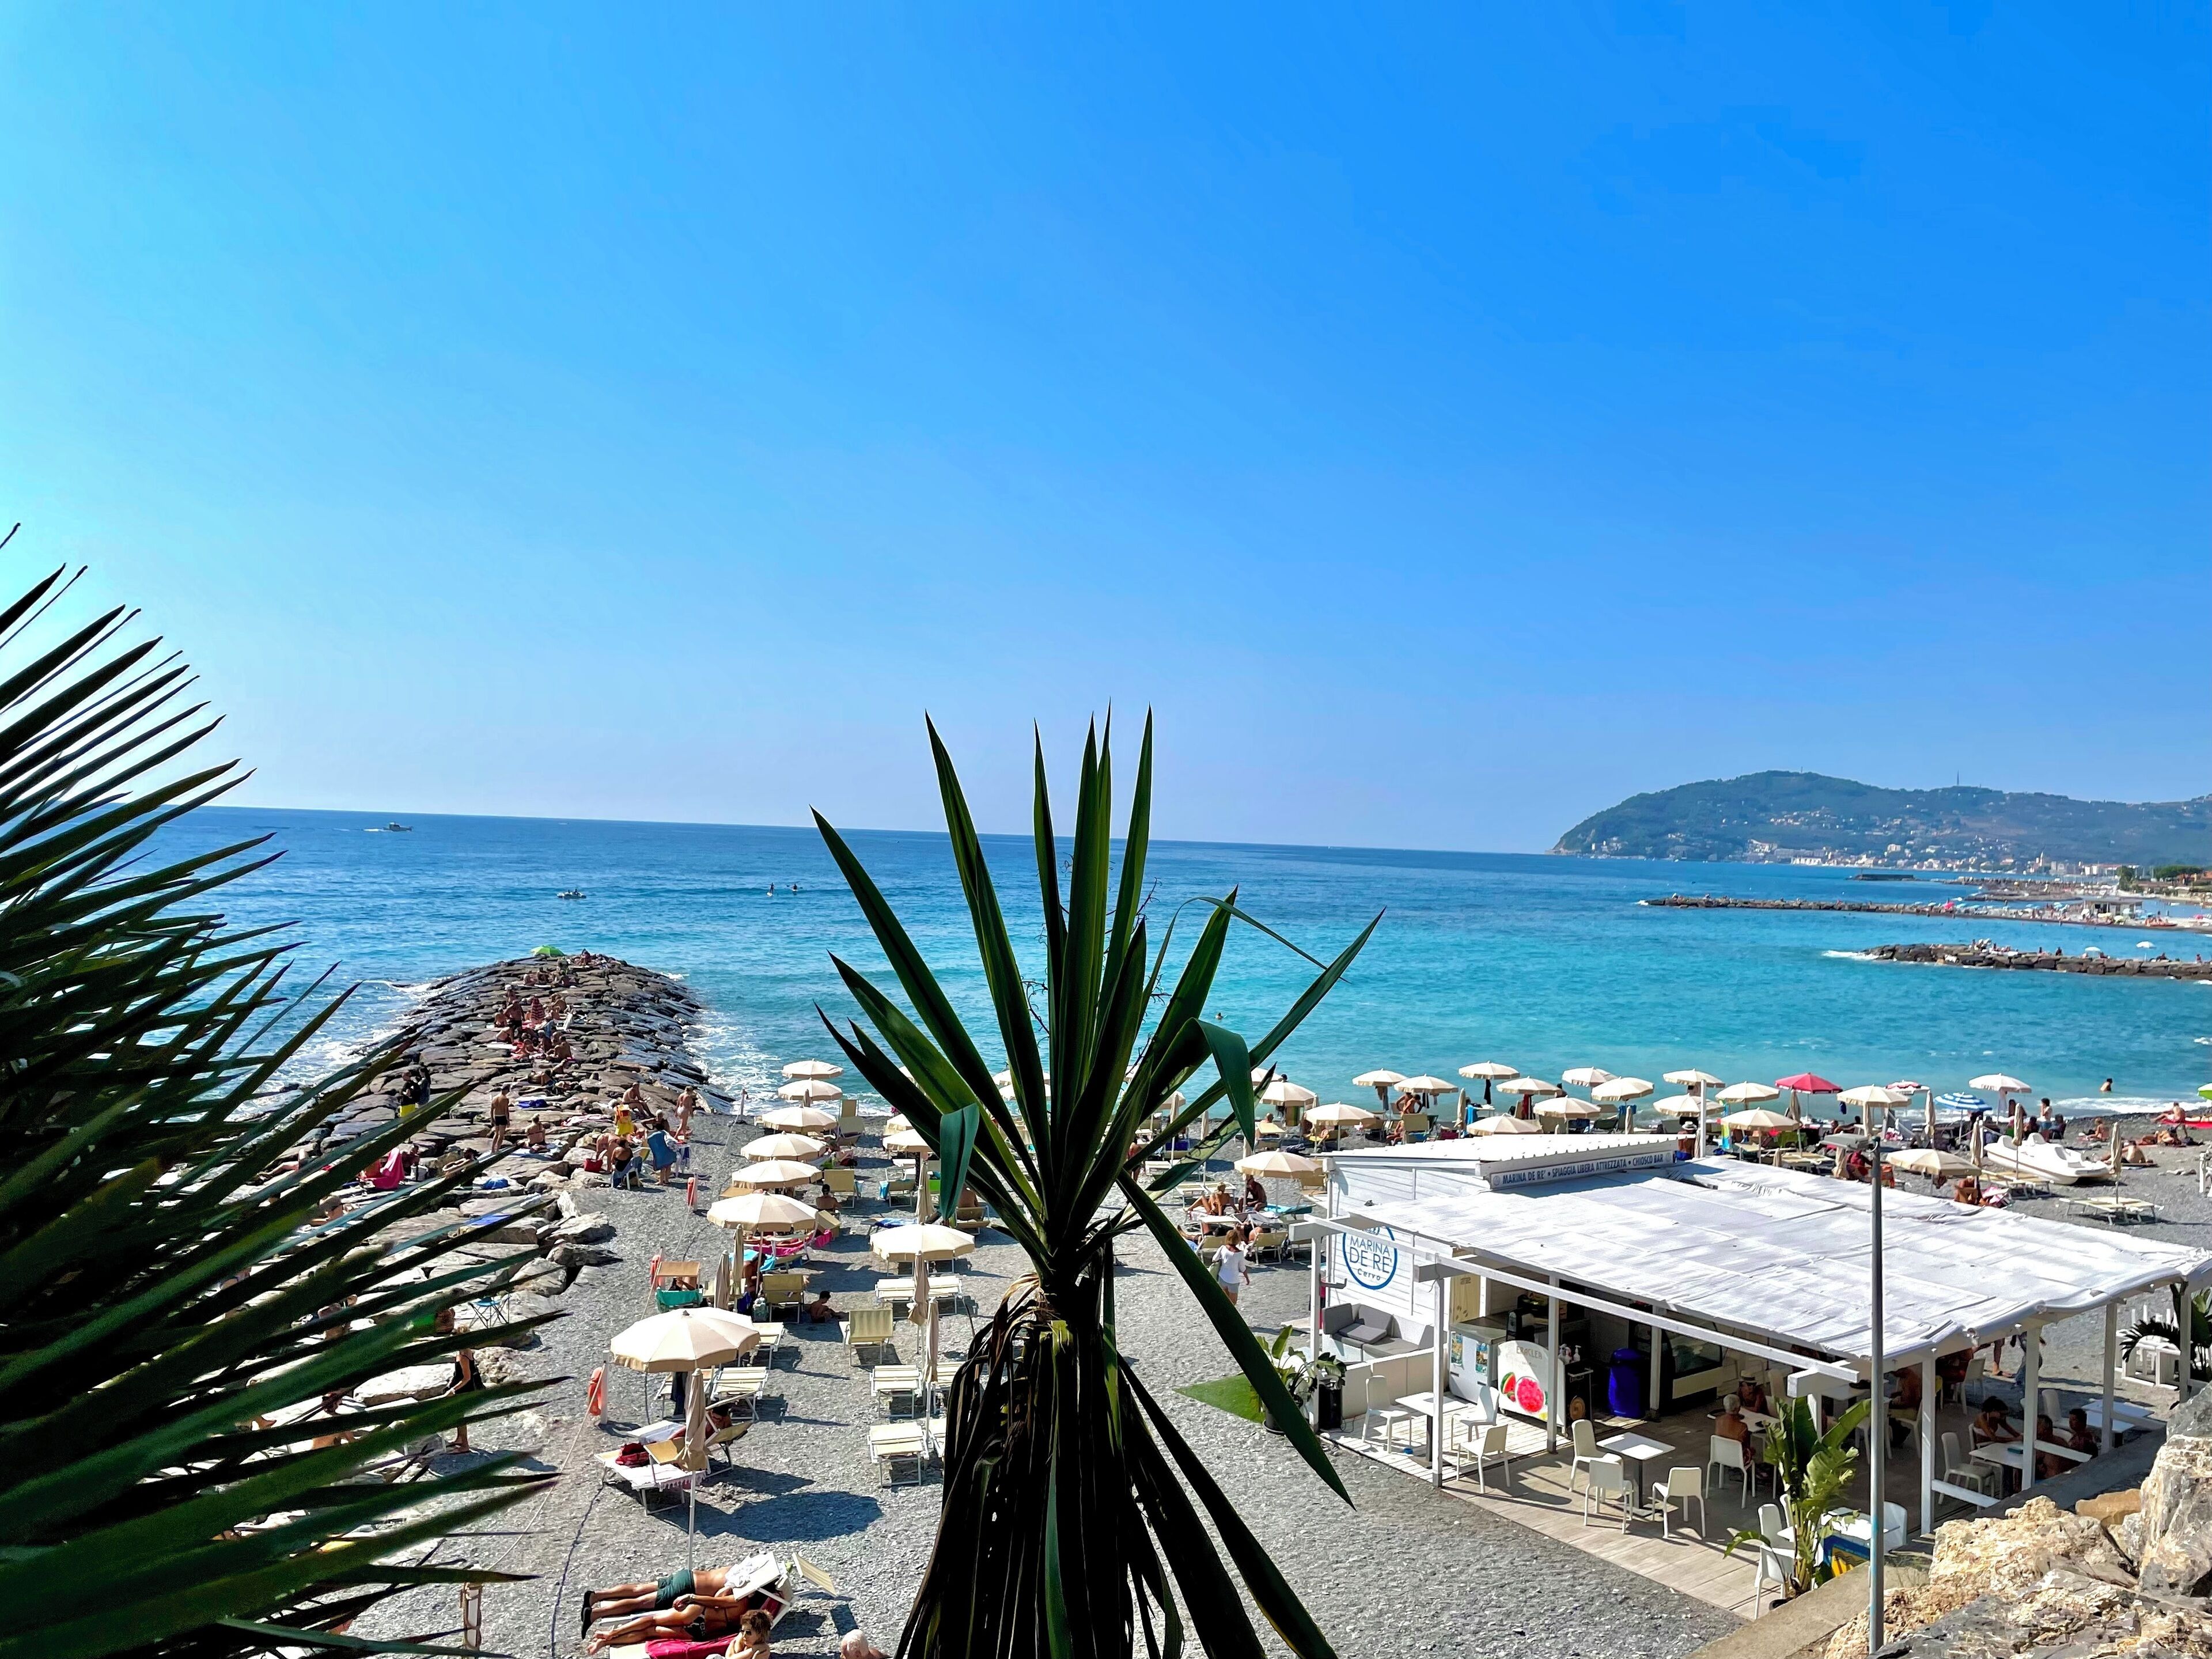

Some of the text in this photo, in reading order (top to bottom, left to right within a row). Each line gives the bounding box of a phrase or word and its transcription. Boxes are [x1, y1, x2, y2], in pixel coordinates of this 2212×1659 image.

[1502, 1172, 1526, 1184] MARINA
[1528, 1171, 1536, 1180] DE
[1552, 1165, 1577, 1177] SPIAGGIA
[1577, 1163, 1594, 1173] LIBERA
[1596, 1158, 1627, 1171] ATTREZZATA
[1633, 1154, 1653, 1166] CHIOSCO
[1654, 1154, 1664, 1163] BAR
[1350, 1236, 1390, 1256] MARINA
[1350, 1247, 1368, 1267] DE
[1357, 1268, 1381, 1281] Cervo
